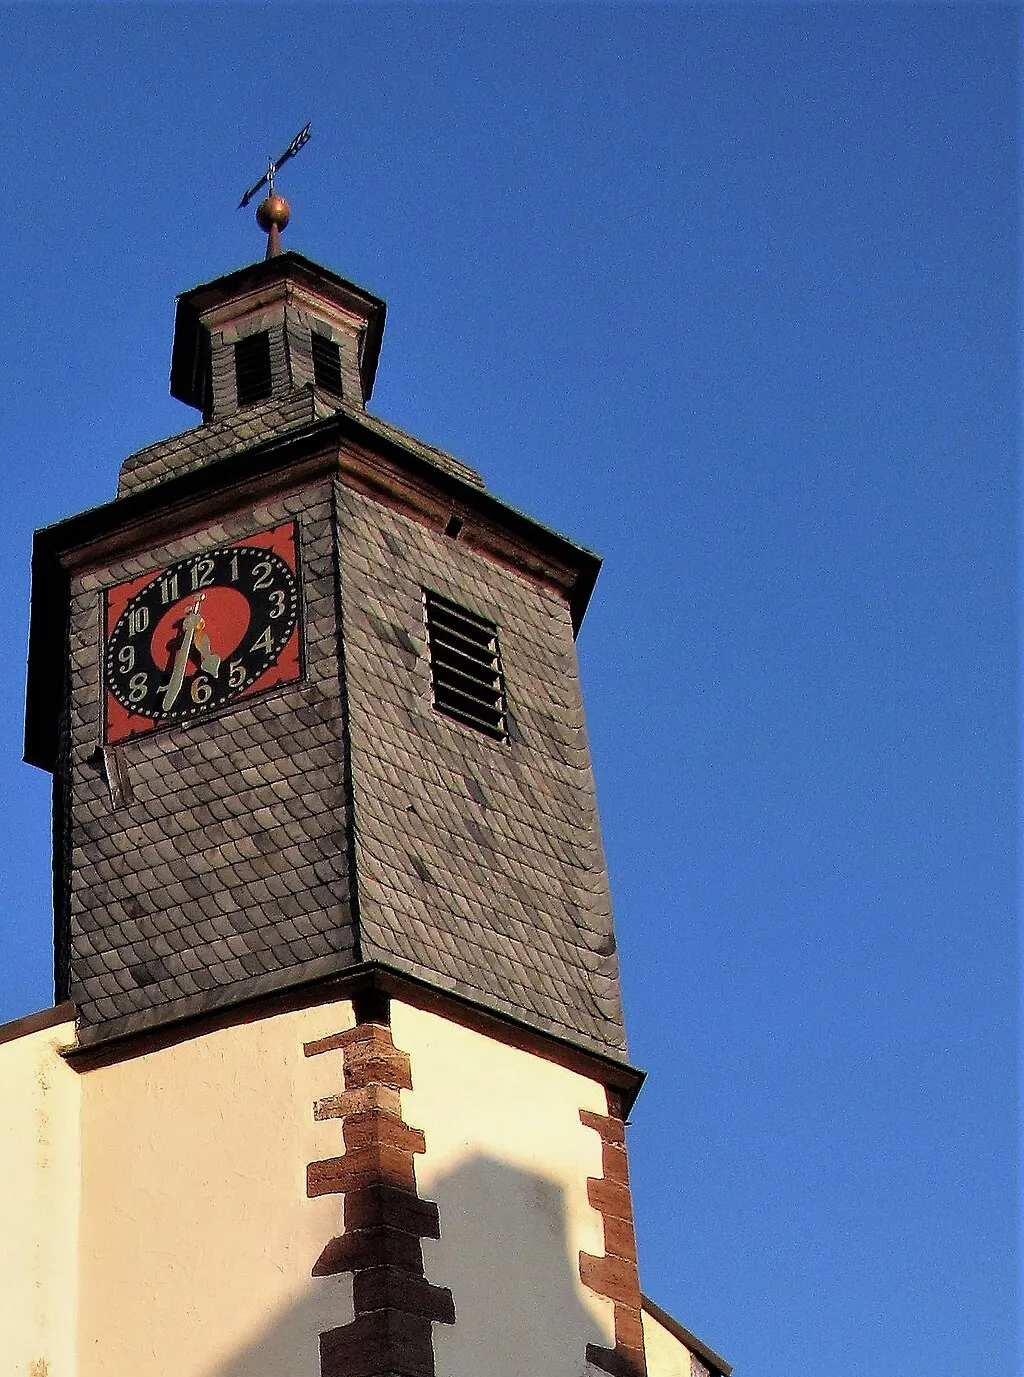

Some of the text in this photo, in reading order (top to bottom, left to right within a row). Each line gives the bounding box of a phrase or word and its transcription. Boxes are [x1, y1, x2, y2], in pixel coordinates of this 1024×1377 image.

[190, 560, 215, 591] 12
[230, 555, 239, 582] 1
[251, 561, 274, 591] 2
[160, 573, 178, 605] 11
[268, 590, 285, 619] 3
[127, 606, 149, 637] 10
[249, 625, 274, 653] 4
[118, 645, 135, 674] 9
[228, 657, 247, 688] 5
[128, 672, 148, 702] 8
[191, 675, 212, 704] 6
